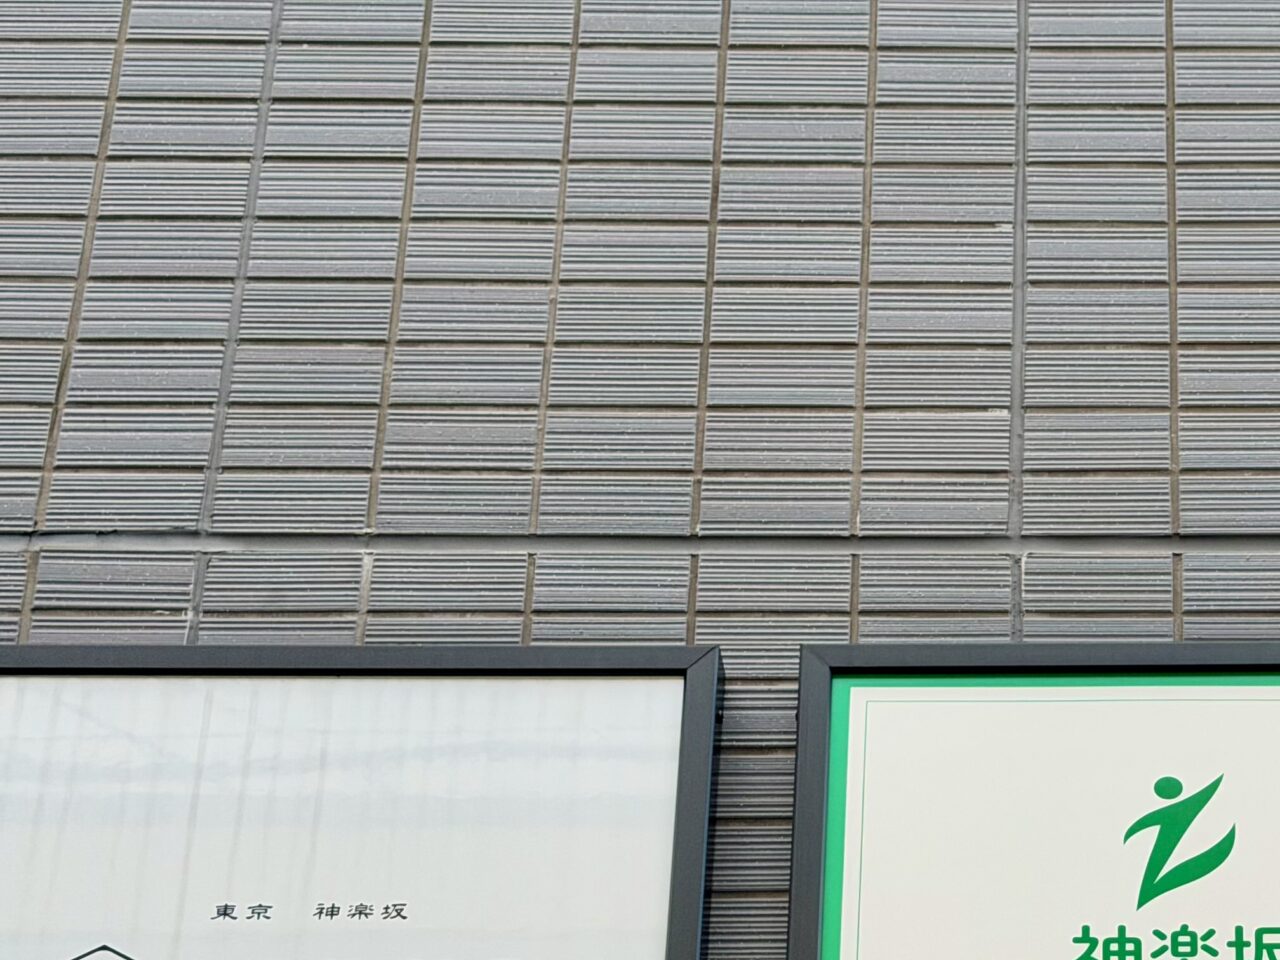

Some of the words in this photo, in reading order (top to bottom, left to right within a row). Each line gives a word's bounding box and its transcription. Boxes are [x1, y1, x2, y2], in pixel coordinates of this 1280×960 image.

[210, 903, 274, 921] 東京
[313, 902, 409, 920] 神楽坂
